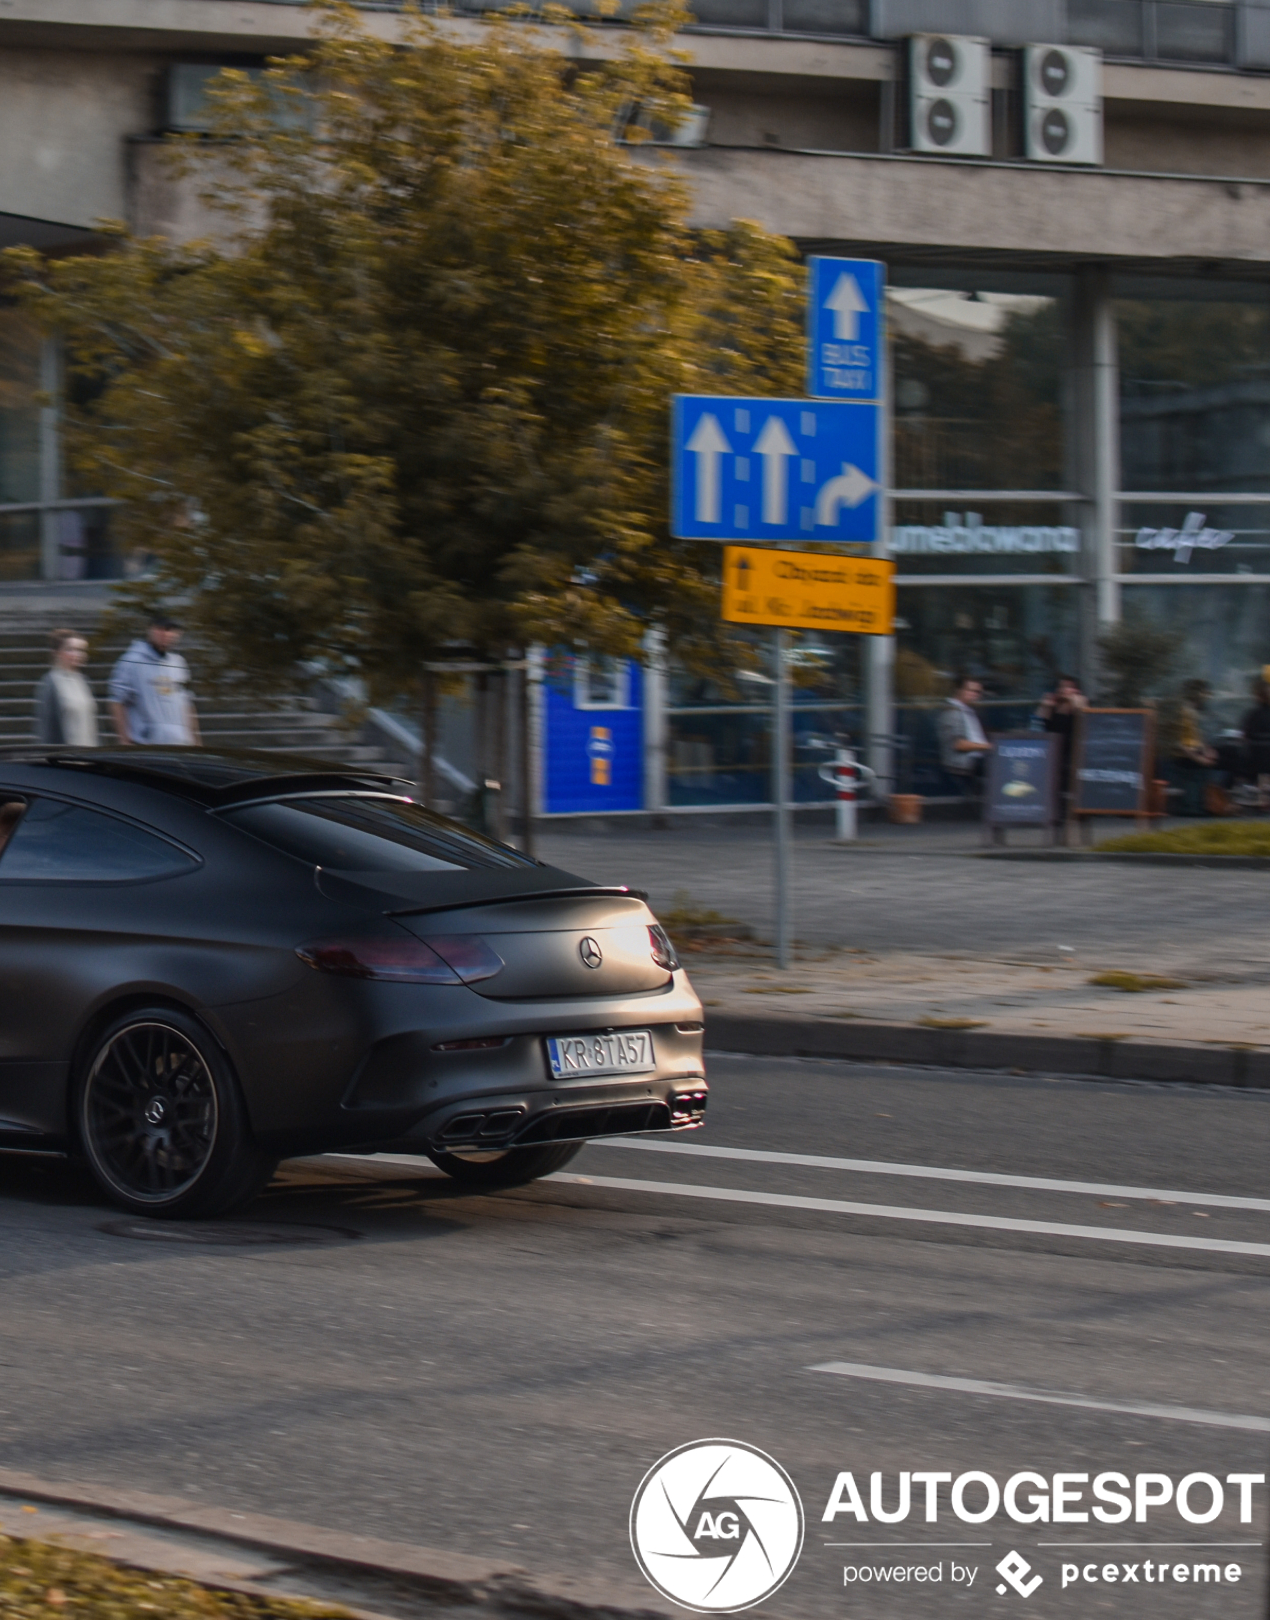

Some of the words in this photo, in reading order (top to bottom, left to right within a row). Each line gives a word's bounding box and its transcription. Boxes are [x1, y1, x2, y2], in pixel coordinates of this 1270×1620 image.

[822, 343, 870, 367] BUS
[821, 366, 872, 390] TAXI
[560, 1038, 591, 1069] KR
